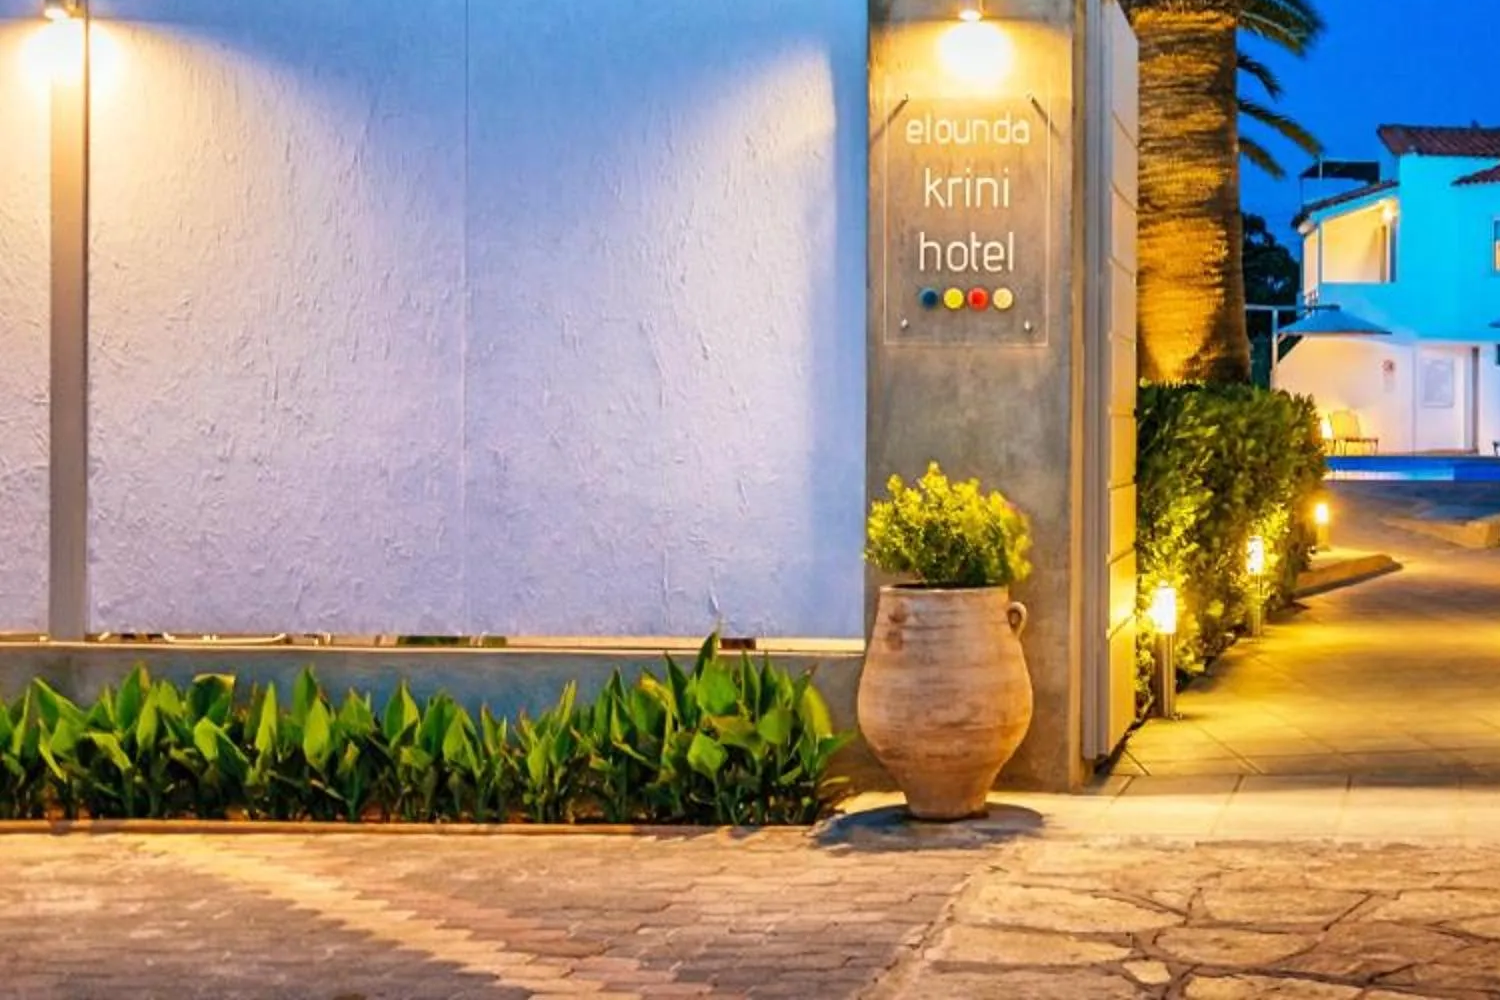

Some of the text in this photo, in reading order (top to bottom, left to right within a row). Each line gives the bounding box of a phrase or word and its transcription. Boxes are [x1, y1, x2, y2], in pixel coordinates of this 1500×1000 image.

[905, 113, 1031, 144] elounda
[924, 167, 1009, 208] krini
[919, 231, 1014, 272] hotel
